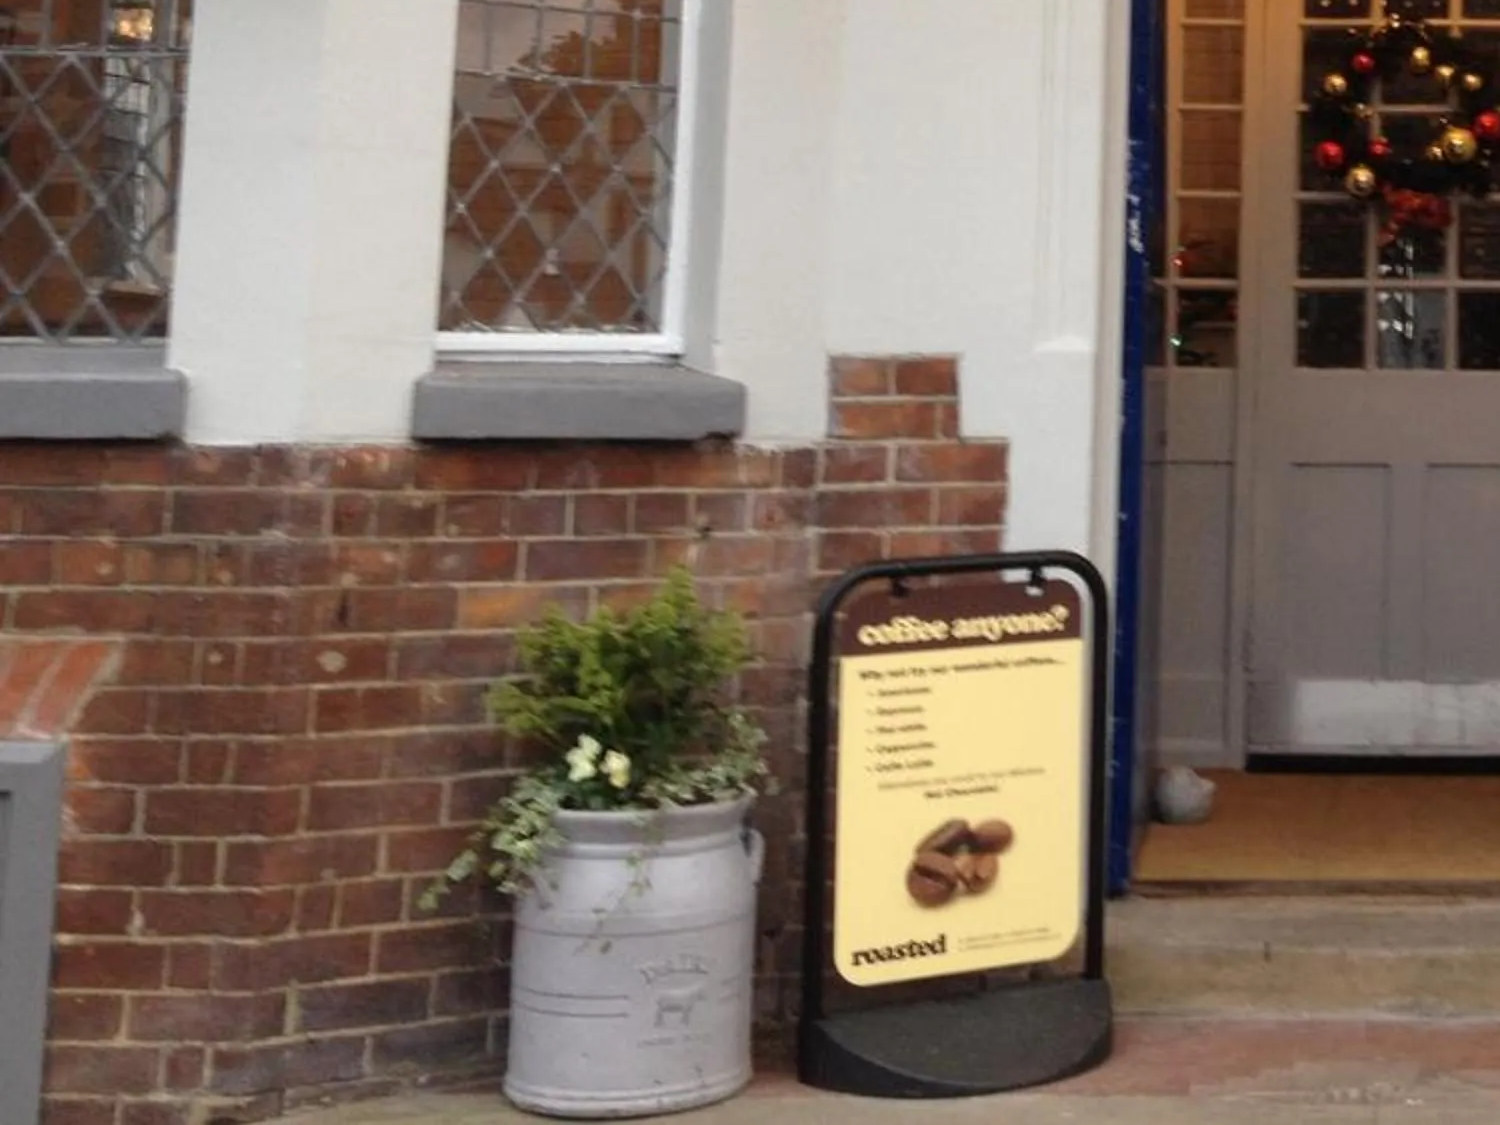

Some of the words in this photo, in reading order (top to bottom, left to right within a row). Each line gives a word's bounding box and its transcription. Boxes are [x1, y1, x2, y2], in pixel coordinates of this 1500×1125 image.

[857, 616, 949, 645] coffee
[951, 604, 1069, 641] anyone?
[851, 934, 947, 967] roasted
